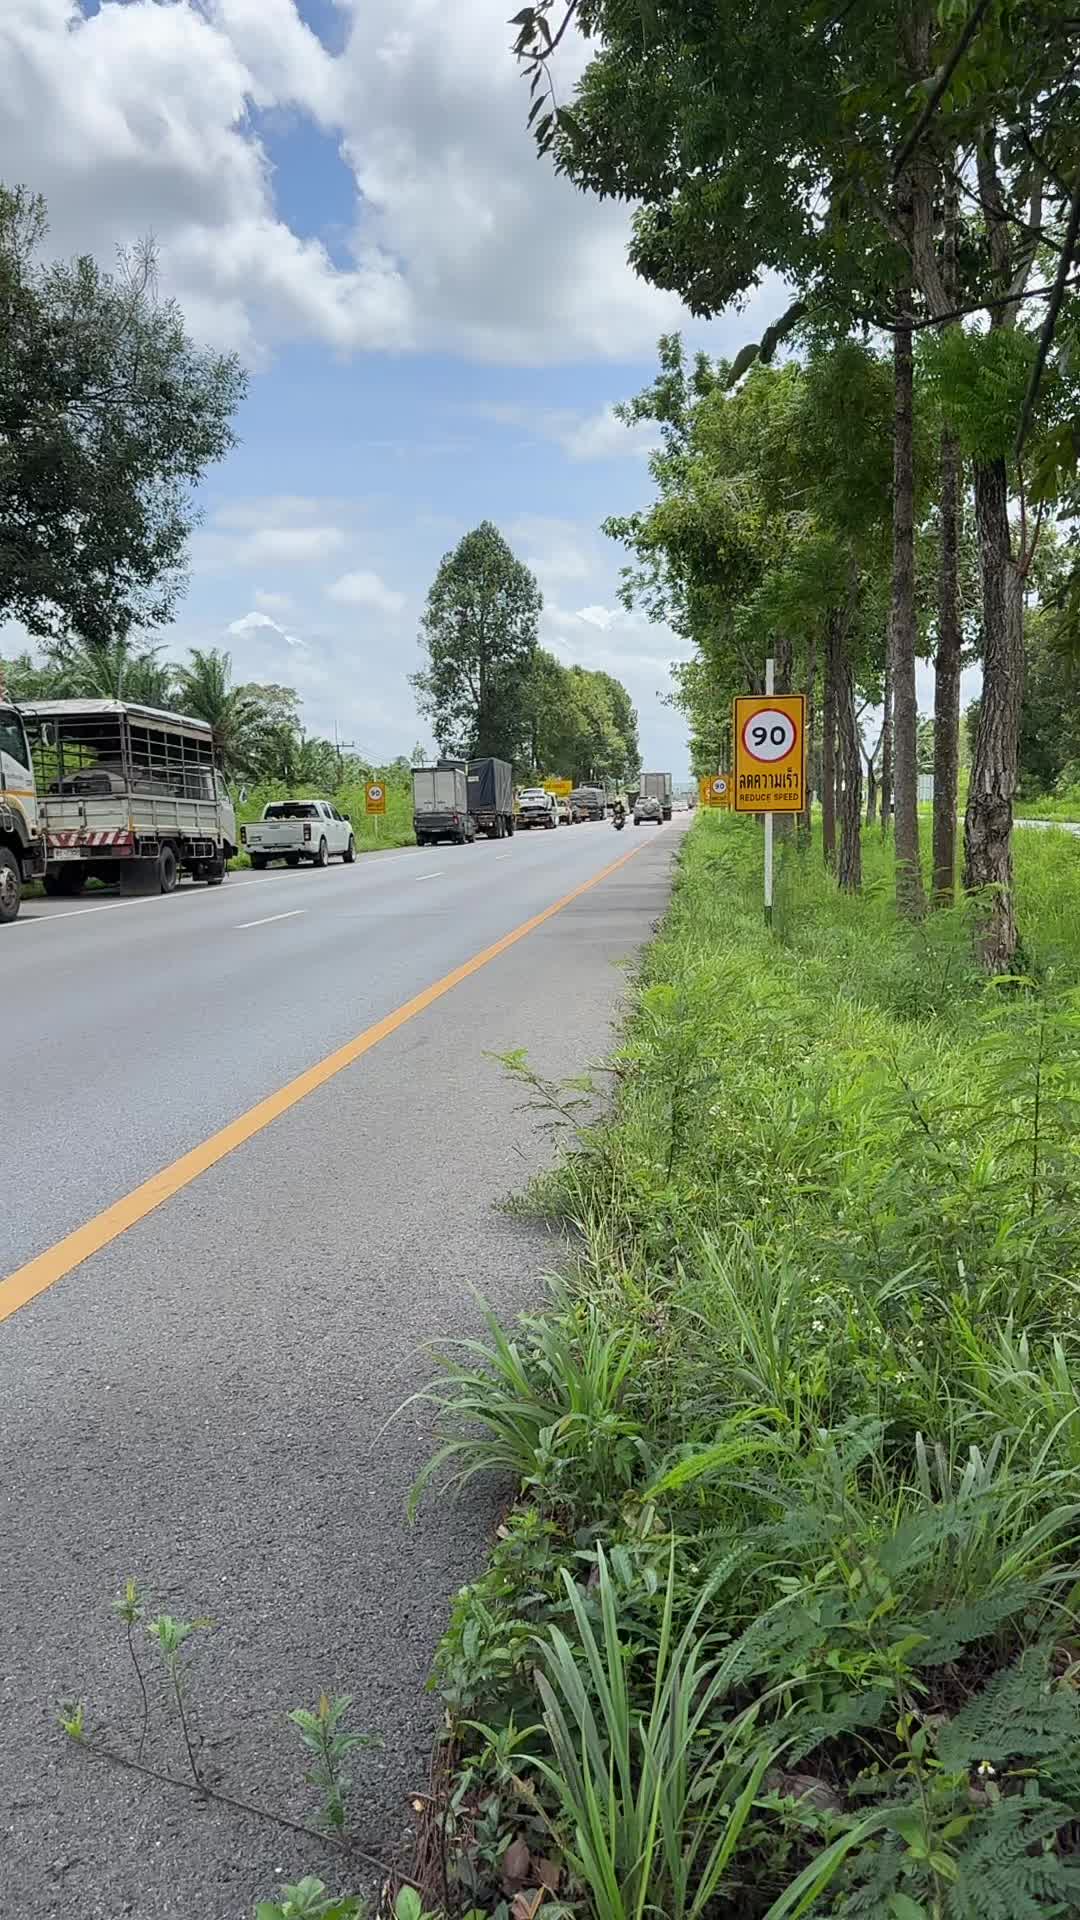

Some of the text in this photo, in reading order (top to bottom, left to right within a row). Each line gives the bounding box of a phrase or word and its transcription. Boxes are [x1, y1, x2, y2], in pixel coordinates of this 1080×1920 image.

[752, 726, 785, 746] 90
[740, 767, 798, 788] ลดความเร็ว
[740, 793, 771, 801] REDUCE
